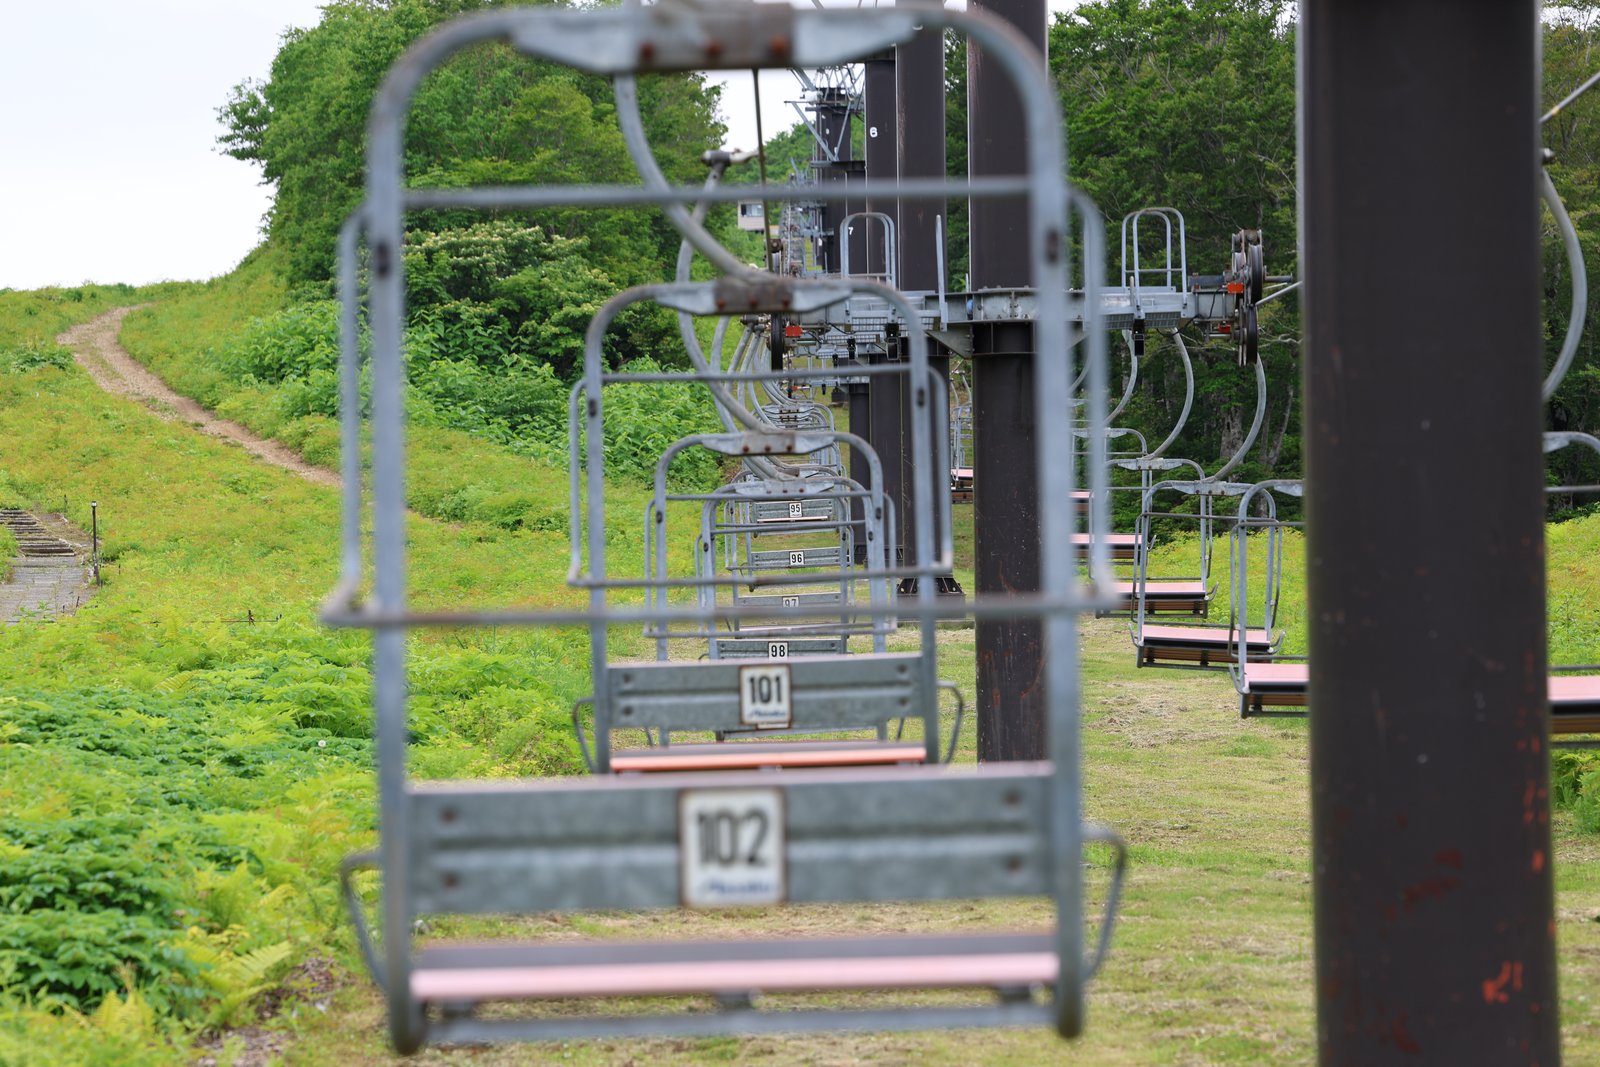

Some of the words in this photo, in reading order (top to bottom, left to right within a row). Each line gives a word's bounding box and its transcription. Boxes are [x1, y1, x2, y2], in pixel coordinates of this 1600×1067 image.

[848, 226, 854, 235] 7
[791, 504, 801, 513] 95
[791, 554, 802, 563] 96
[772, 645, 785, 657] 98
[749, 675, 782, 704] 101
[697, 806, 770, 867] 102
